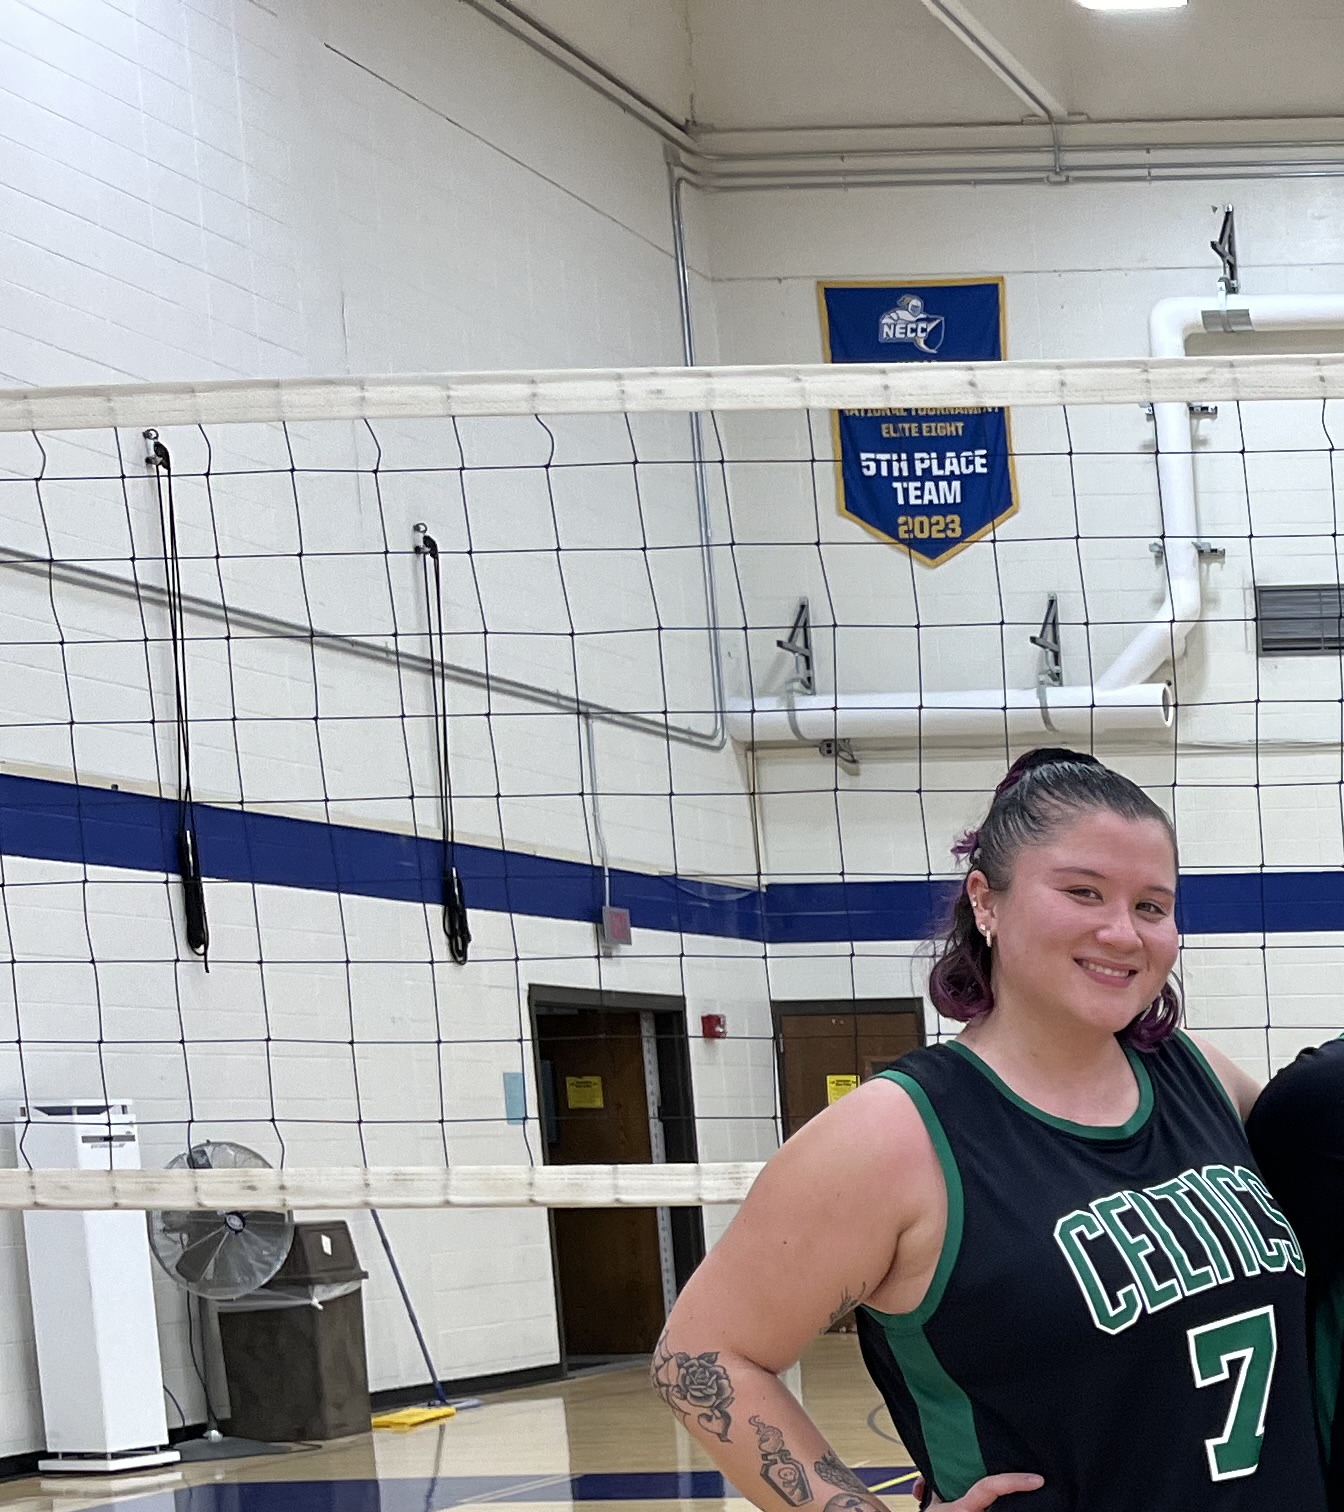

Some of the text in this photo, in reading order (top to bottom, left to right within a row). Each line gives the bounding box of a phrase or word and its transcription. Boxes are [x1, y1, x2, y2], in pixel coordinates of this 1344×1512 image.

[883, 322, 928, 340] NECC
[881, 421, 964, 438] ELITE EIGHT
[860, 450, 988, 476] 5TH PLACE
[892, 481, 961, 505] TEAM
[898, 514, 962, 539] 2023
[1053, 1164, 1306, 1336] CELTICS
[1187, 1304, 1277, 1482] 7
